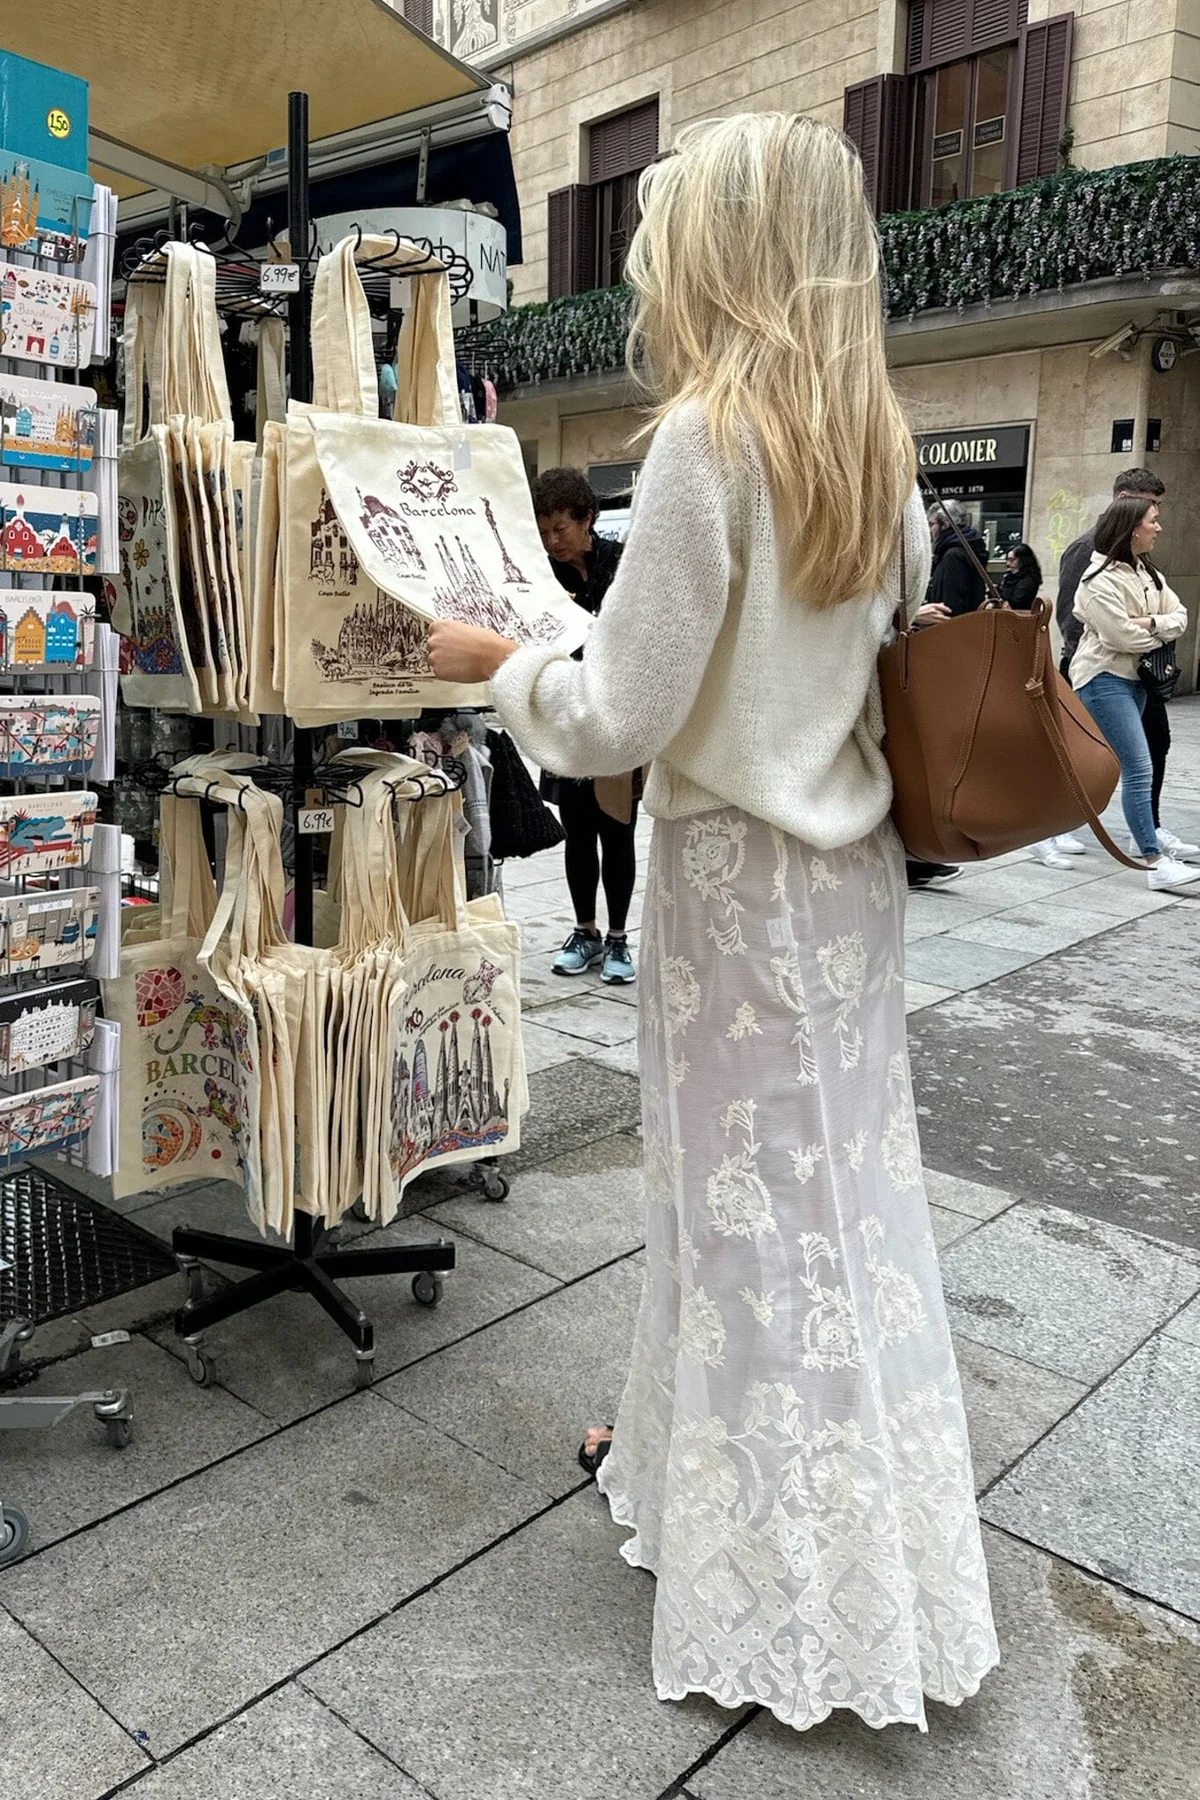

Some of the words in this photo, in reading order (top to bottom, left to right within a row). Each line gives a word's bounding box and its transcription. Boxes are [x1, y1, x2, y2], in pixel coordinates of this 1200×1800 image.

[262, 266, 298, 284] 6.99€
[919, 438, 997, 466] COLOMER
[941, 486, 965, 495] SINCE
[399, 502, 476, 517] Barcelona
